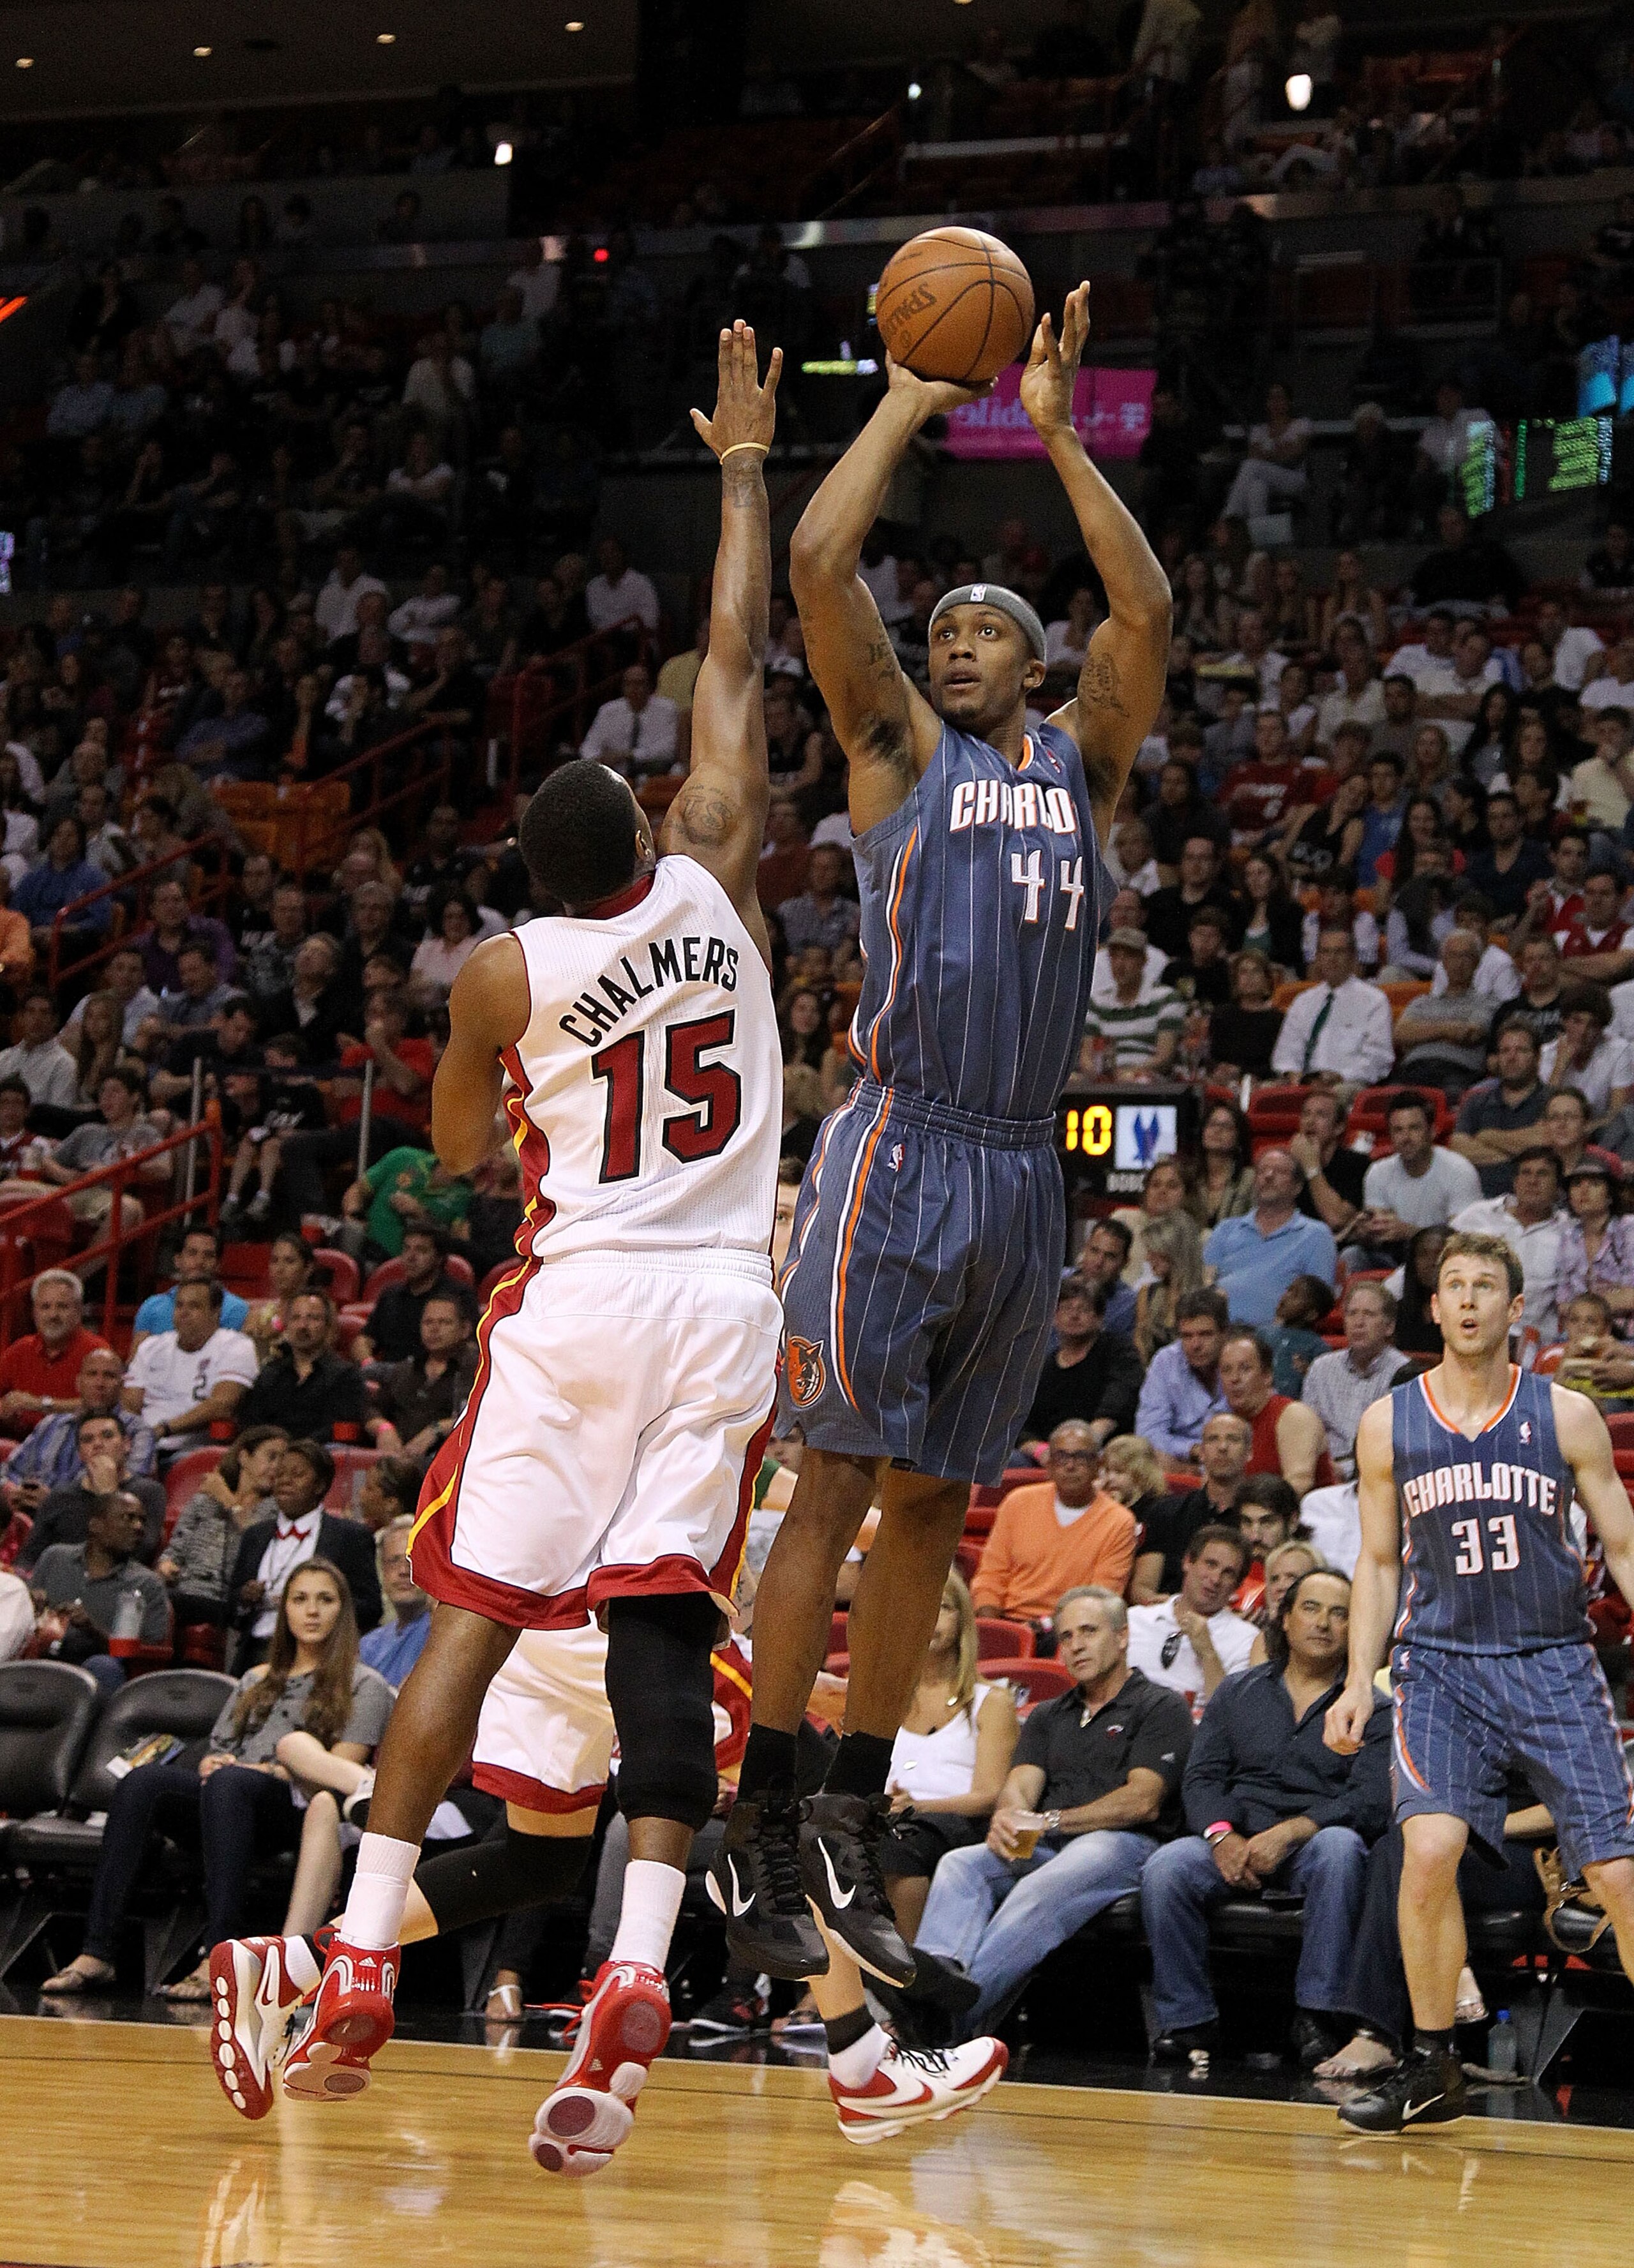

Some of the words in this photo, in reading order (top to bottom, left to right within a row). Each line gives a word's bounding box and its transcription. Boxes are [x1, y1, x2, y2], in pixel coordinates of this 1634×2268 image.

[1010, 849, 1085, 931] 44
[558, 936, 739, 1048] CHALMERS
[590, 1006, 743, 1186] 15
[1065, 1105, 1113, 1156] 10
[1403, 1461, 1557, 1518] CHARLOTTE
[1451, 1514, 1521, 1576] 33
